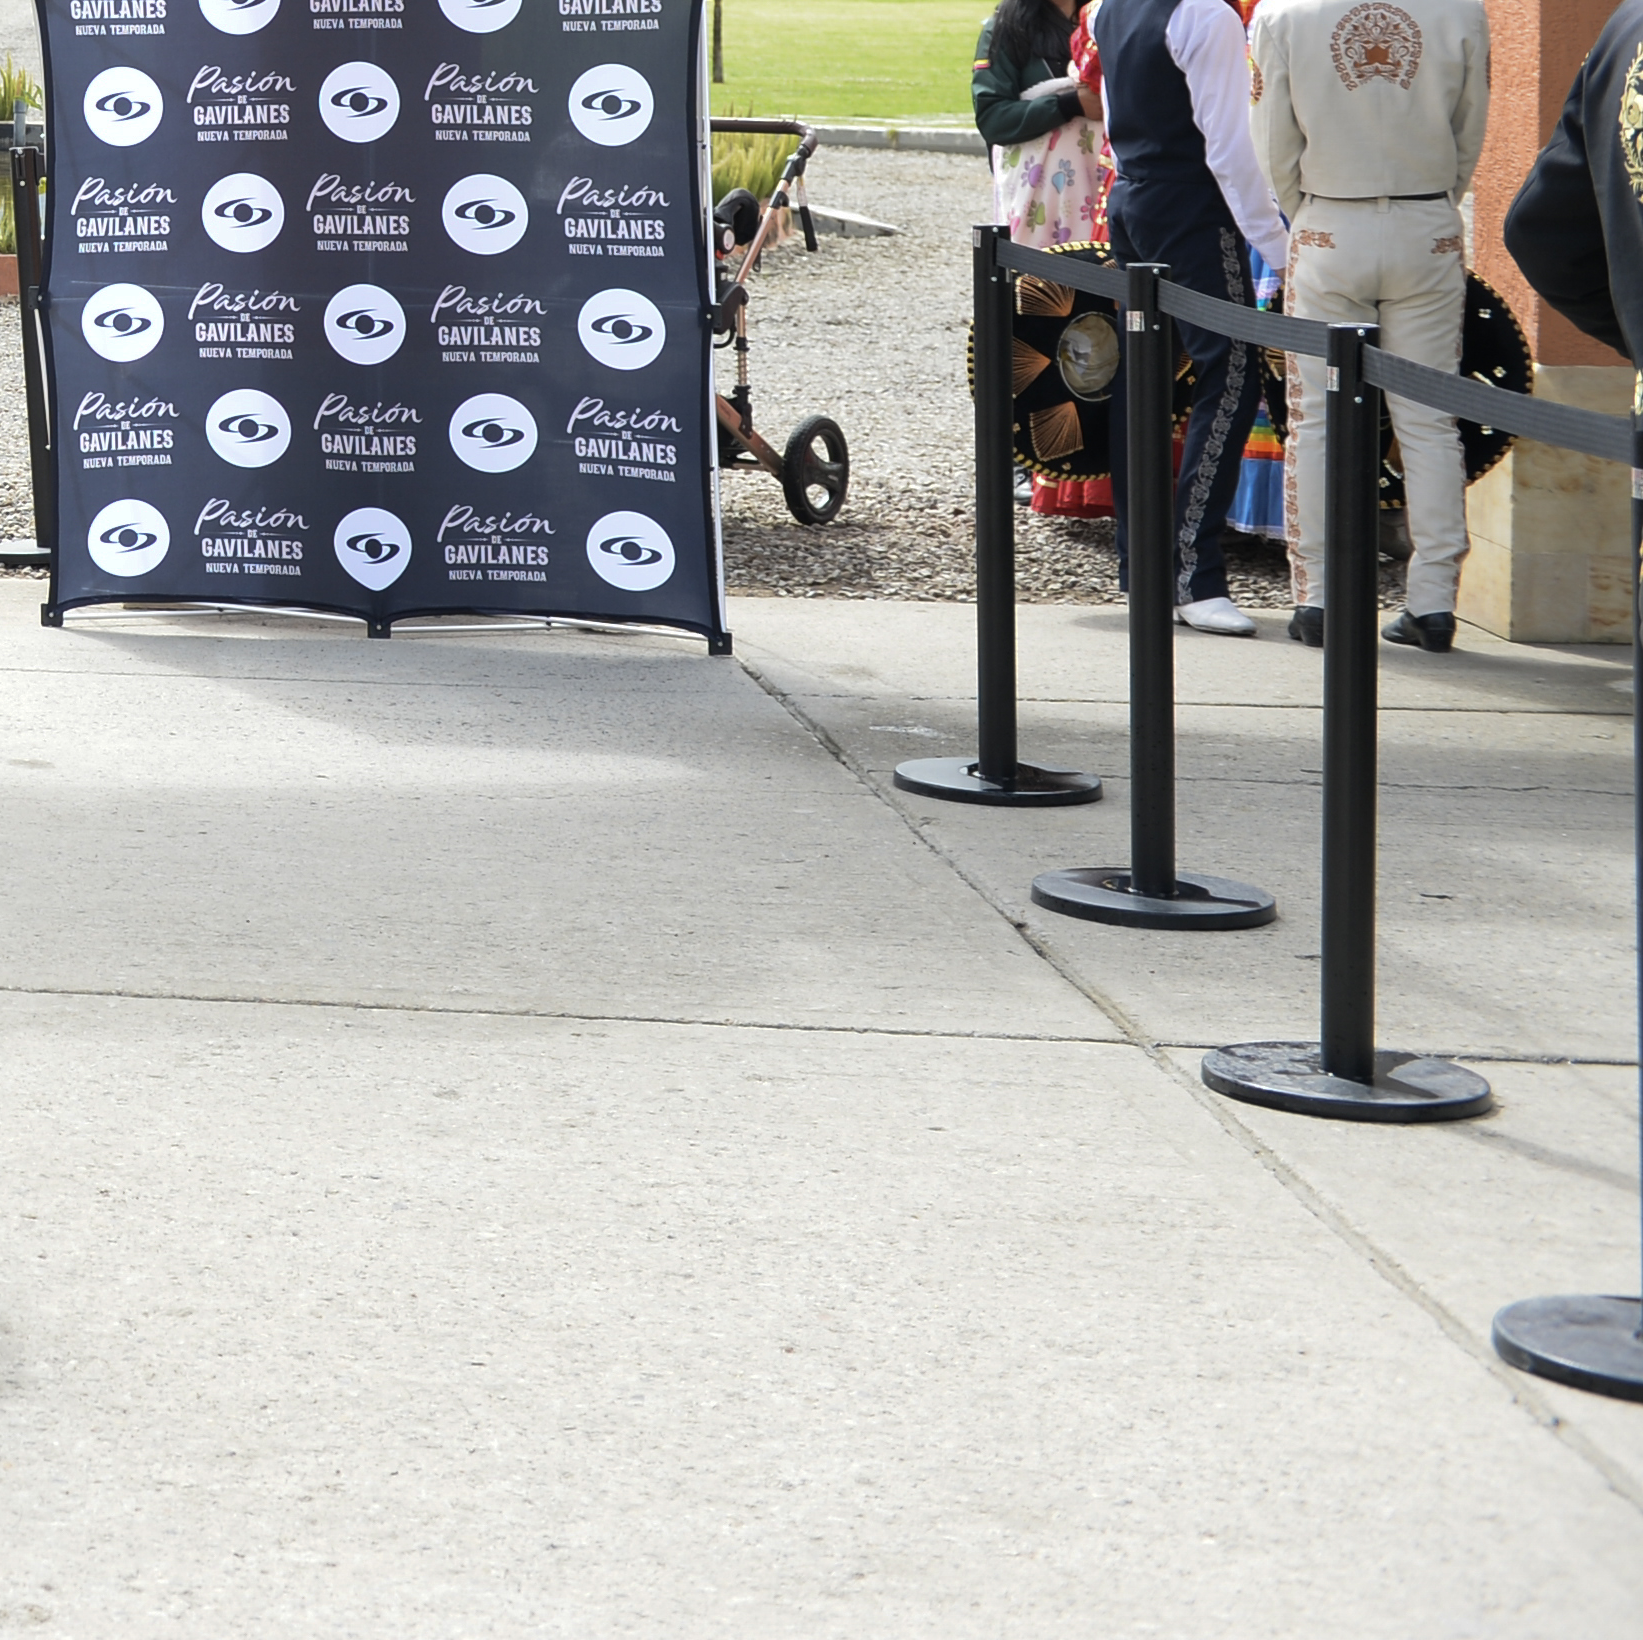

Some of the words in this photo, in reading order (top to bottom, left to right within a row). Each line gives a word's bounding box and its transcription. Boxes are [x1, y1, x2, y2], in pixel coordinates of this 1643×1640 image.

[70, 0, 167, 20] GAVILANES
[75, 24, 107, 36] NUEVA
[109, 23, 166, 36] TEMPORADA
[313, 18, 345, 30] NUEVA
[347, 17, 403, 29] TEMPORADA
[562, 20, 597, 32] NUEVA
[600, 18, 659, 31] TEMPORADA
[186, 64, 296, 104] Pasión
[424, 62, 539, 101] Pasión
[193, 104, 290, 126] GAVILANES
[431, 103, 533, 126] GAVILANES
[197, 130, 230, 142] NUEVA
[232, 129, 288, 141] TEMPORADA
[435, 129, 469, 141] NUEVA
[472, 130, 531, 142] TEMPORADA
[70, 176, 177, 216] Pasión
[305, 172, 416, 212] Pasión
[556, 176, 670, 215] Pasión
[76, 215, 171, 238] GAVILANES
[313, 214, 410, 235] GAVILANES
[564, 217, 665, 240] GAVILANES
[78, 241, 110, 254] NUEVA
[112, 240, 168, 253] TEMPORADA
[317, 240, 349, 251] NUEVA
[352, 240, 409, 252] TEMPORADA
[568, 243, 603, 255] NUEVA
[606, 244, 665, 257] TEMPORADA
[187, 281, 300, 321] Pasión
[430, 284, 547, 324] Pasión
[195, 322, 295, 343] GAVILANES
[438, 326, 541, 347] GAVILANES
[199, 347, 233, 358] NUEVA
[235, 347, 293, 359] TEMPORADA
[442, 351, 476, 362] NUEVA
[479, 351, 540, 363] TEMPORADA
[73, 391, 179, 431] Pasión
[313, 392, 423, 431] Pasión
[566, 396, 682, 434] Pasión
[79, 429, 174, 453] GAVILANES
[321, 433, 417, 456] GAVILANES
[574, 436, 677, 466] GAVILANES
[83, 456, 114, 469] NUEVA
[116, 454, 172, 467] TEMPORADA
[325, 458, 358, 472] NUEVA
[361, 461, 415, 473] TEMPORADA
[579, 462, 615, 476] NUEVA
[617, 465, 676, 483] TEMPORADA
[193, 497, 309, 536] Pasión
[436, 504, 556, 543] Pasión
[201, 537, 303, 560] GAVILANES
[444, 544, 549, 566] GAVILANES
[205, 562, 240, 574] NUEVA
[242, 563, 301, 576] TEMPORADA
[448, 569, 483, 581] NUEVA
[486, 569, 547, 582] TEMPORADA
